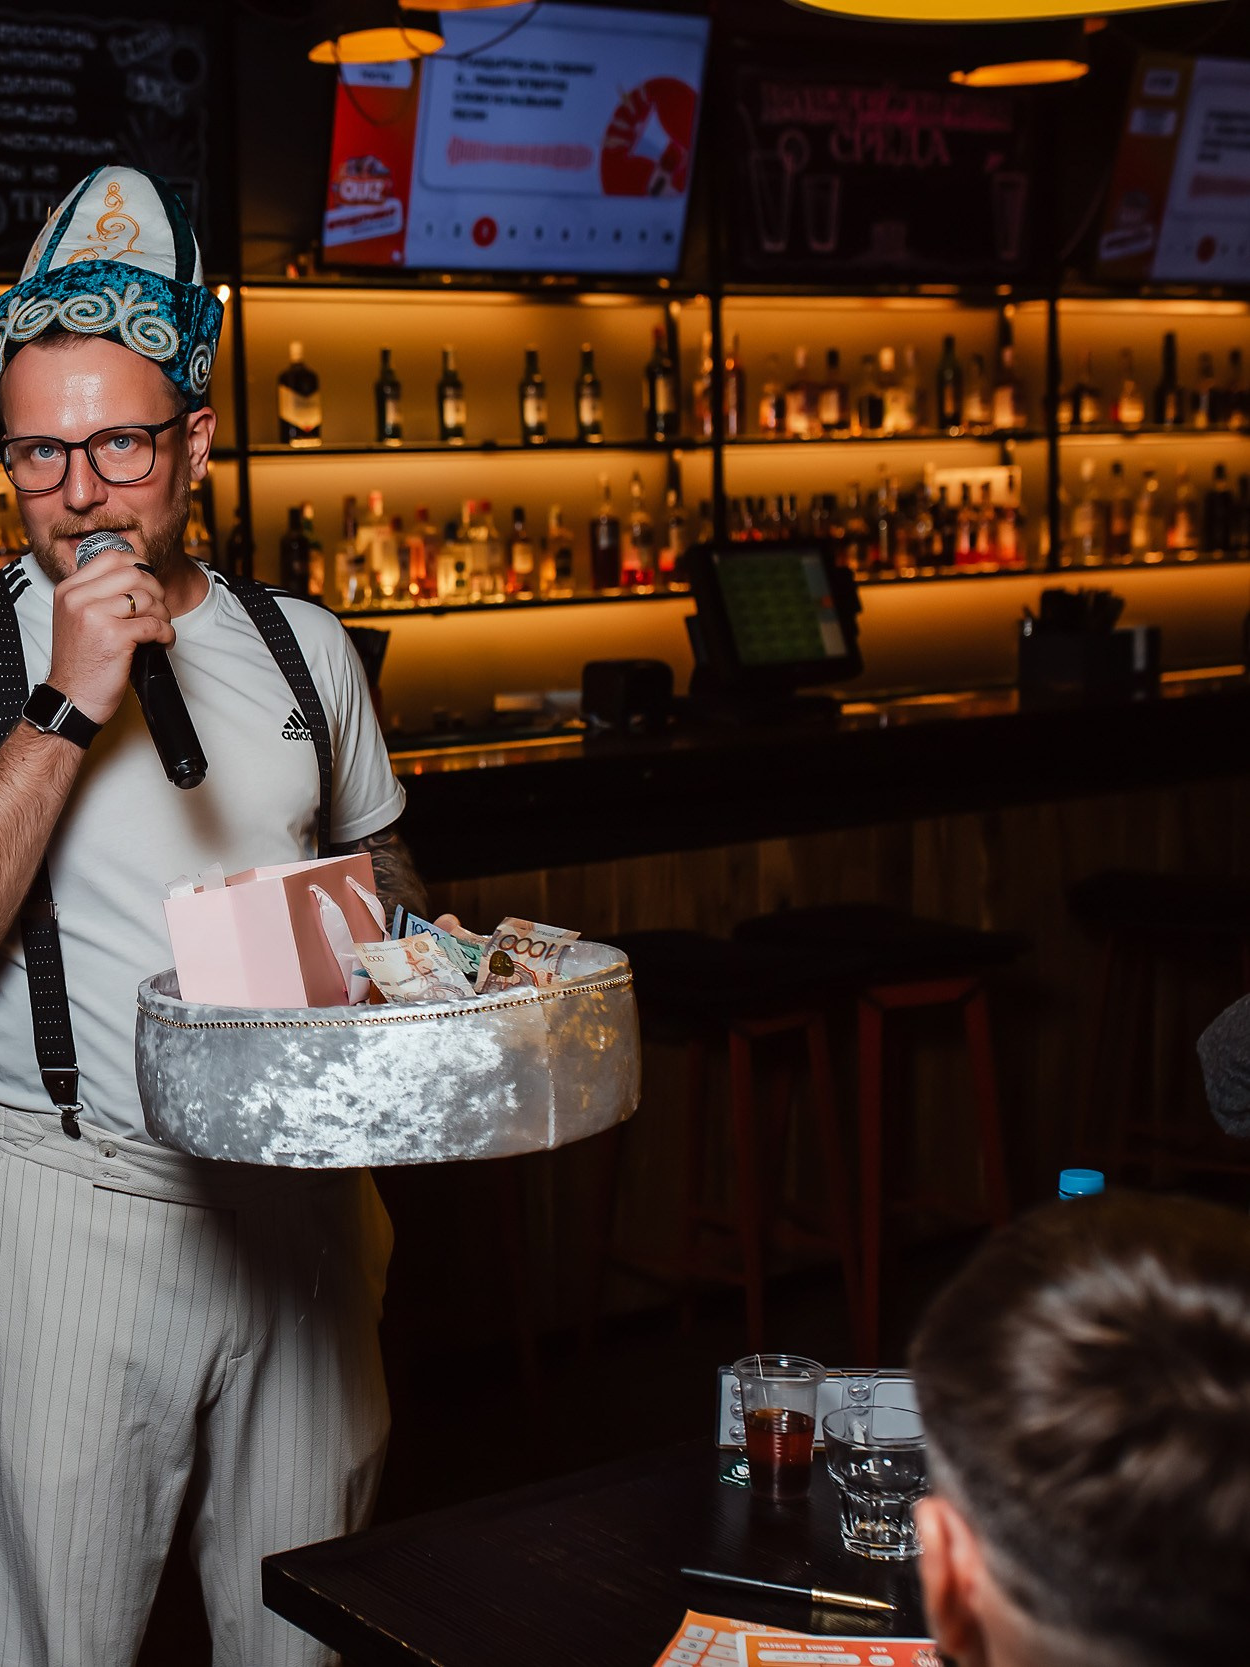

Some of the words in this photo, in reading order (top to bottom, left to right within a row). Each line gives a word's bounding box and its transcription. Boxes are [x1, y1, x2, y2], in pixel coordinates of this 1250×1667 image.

[281, 728, 313, 741] adida
[499, 934, 557, 962] 1000
[365, 955, 385, 963] 1000
